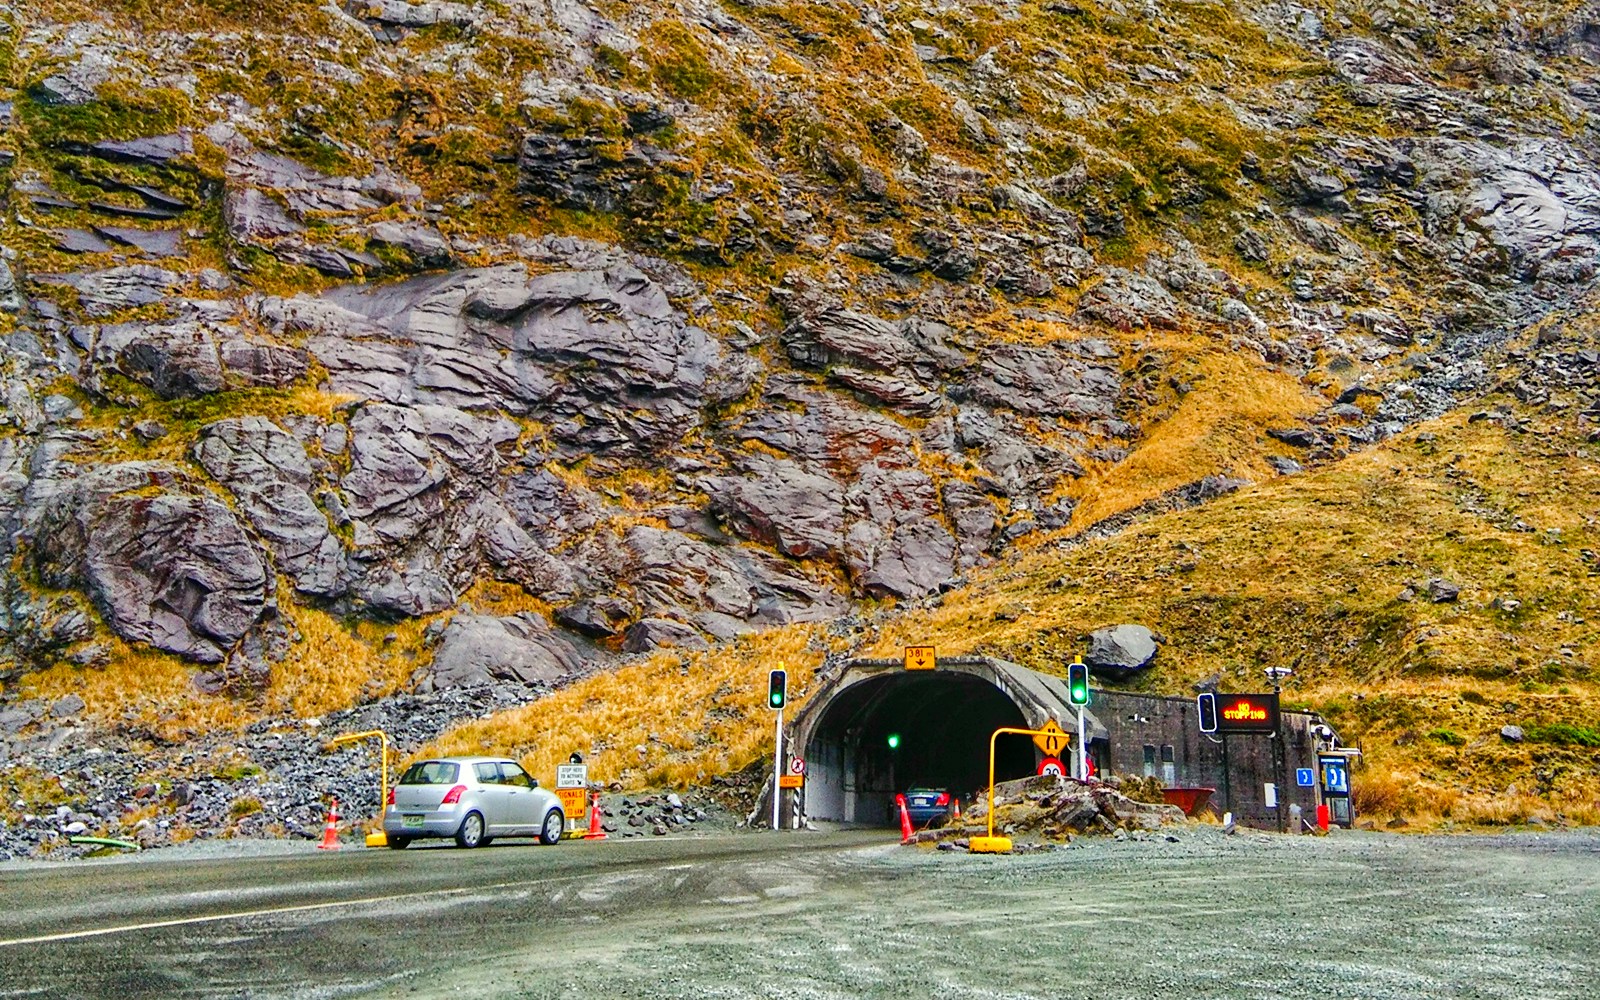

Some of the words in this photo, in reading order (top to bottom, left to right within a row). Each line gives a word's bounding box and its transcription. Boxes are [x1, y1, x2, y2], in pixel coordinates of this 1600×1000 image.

[1238, 703, 1250, 711] NO
[1224, 710, 1266, 720] STOPPING
[558, 791, 583, 799] SIGNALS
